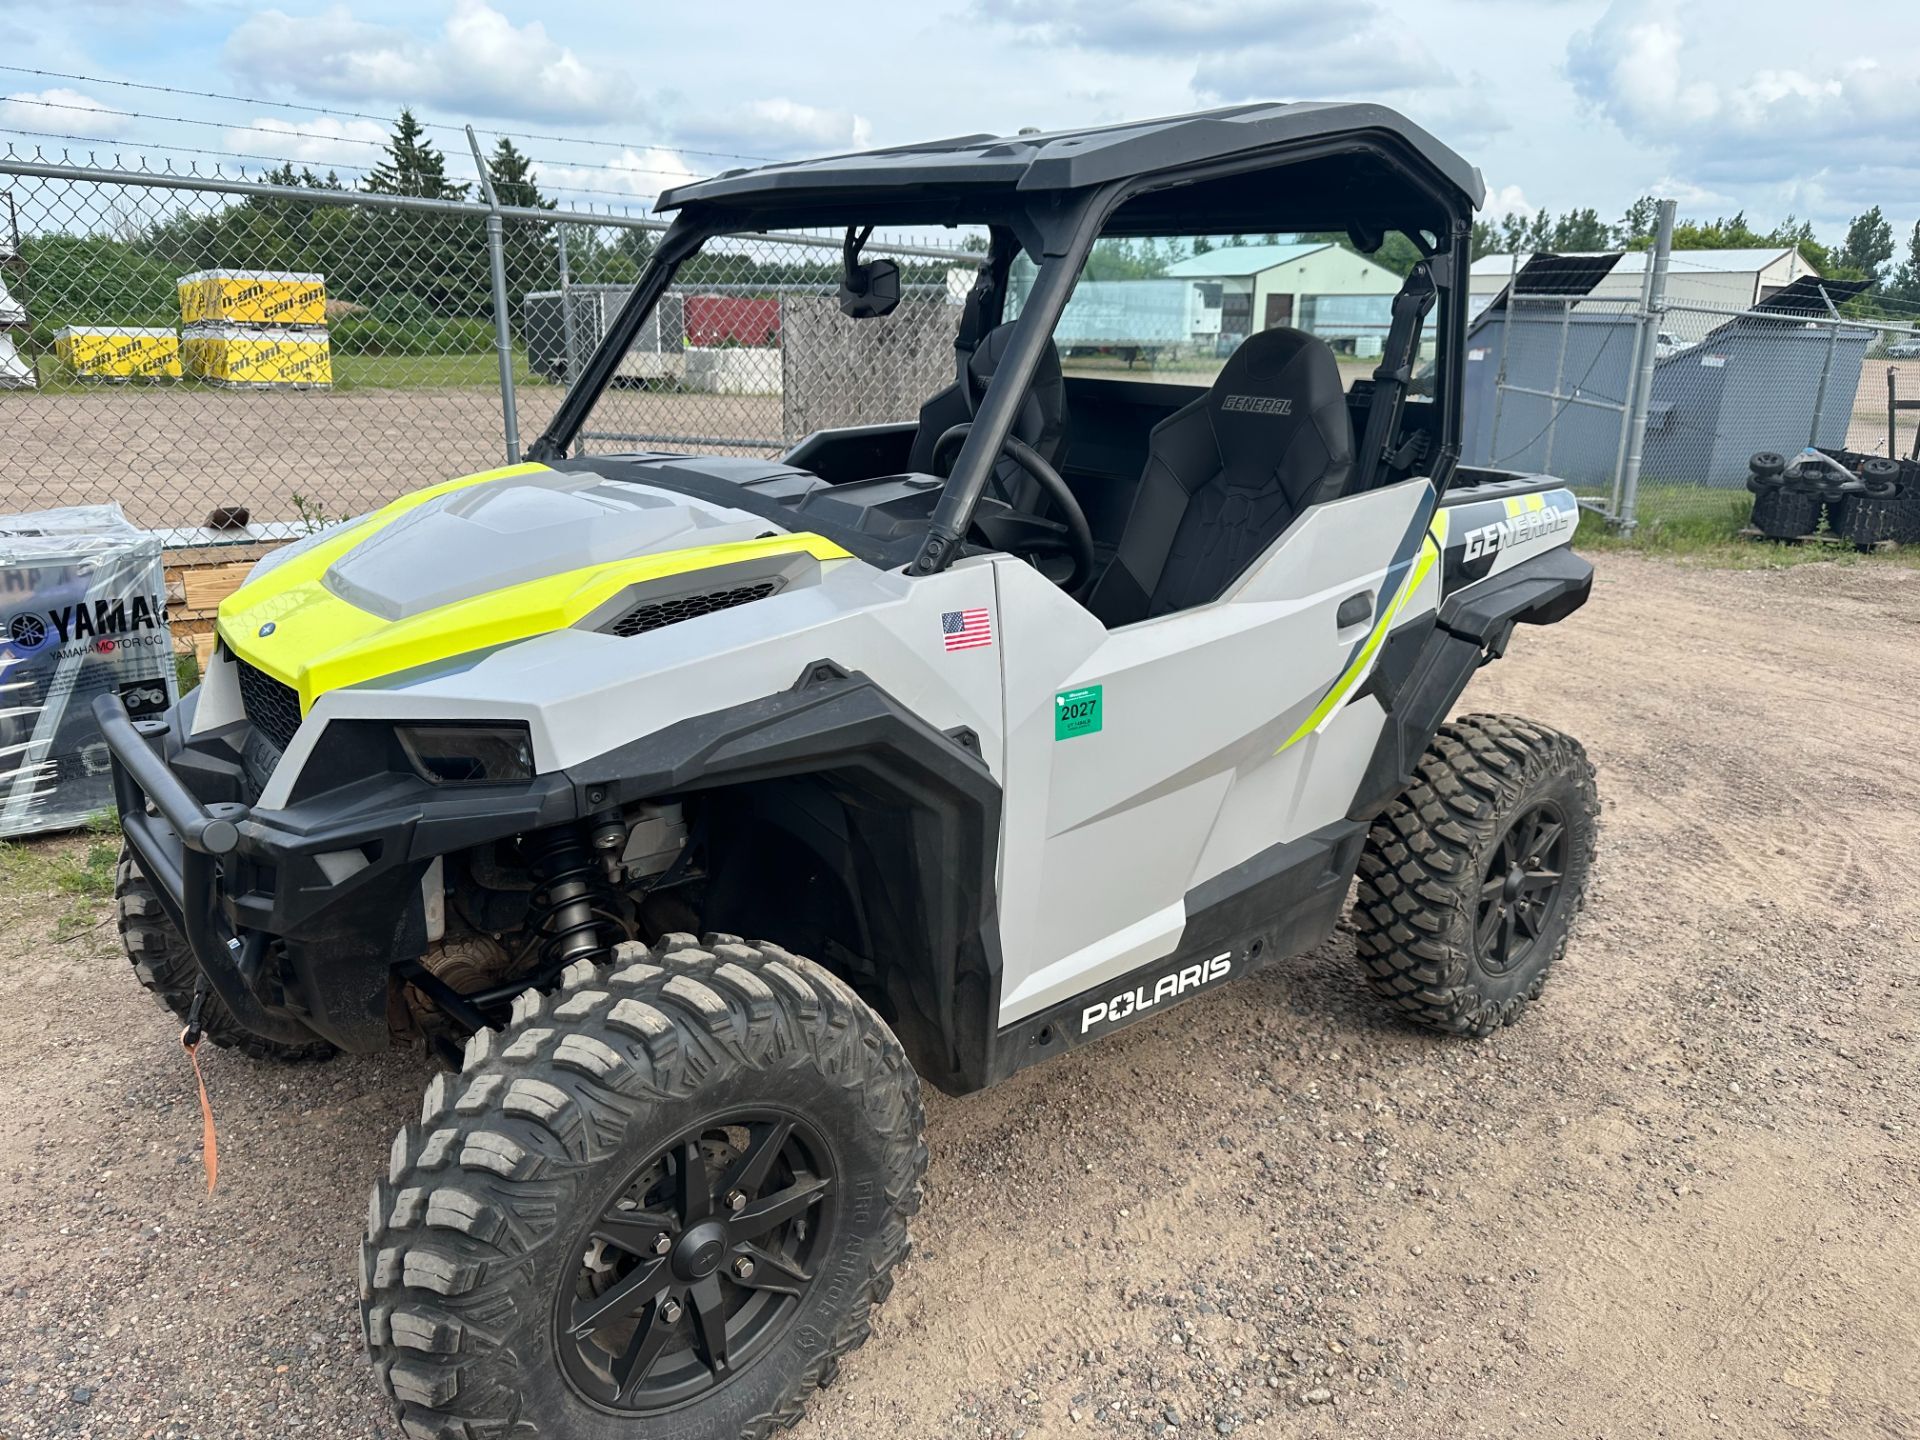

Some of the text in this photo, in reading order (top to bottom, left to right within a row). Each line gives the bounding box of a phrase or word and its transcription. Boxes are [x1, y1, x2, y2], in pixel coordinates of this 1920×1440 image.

[1221, 395, 1292, 415] GENERAL
[1463, 505, 1568, 563] GENERAL
[49, 643, 95, 661] YAMAHA
[95, 637, 141, 655] MOTOR
[1061, 699, 1096, 721] 2027
[1081, 951, 1232, 1034] POLARIS
